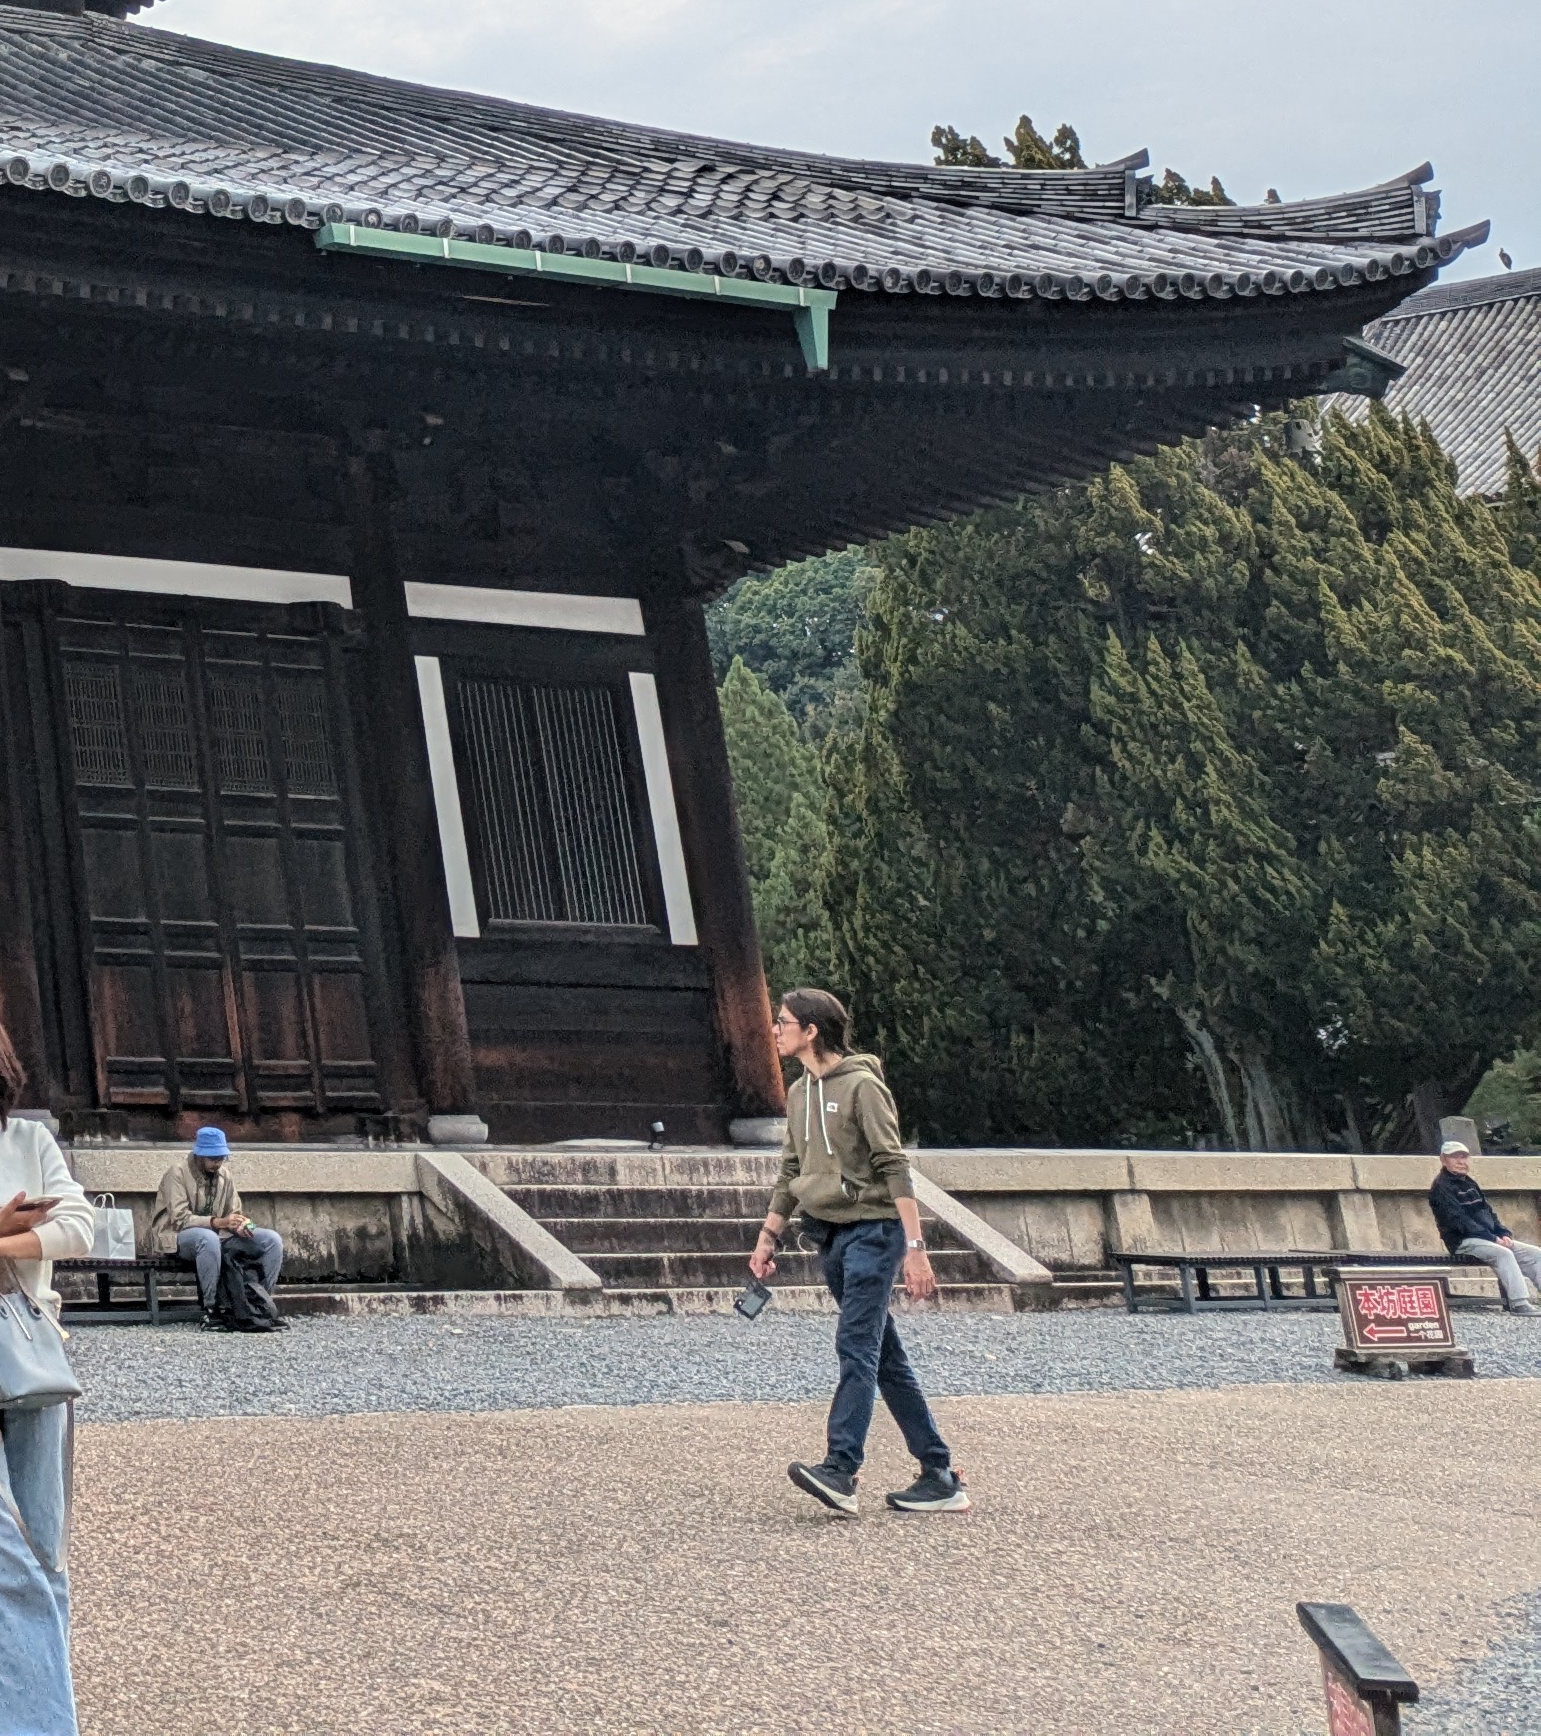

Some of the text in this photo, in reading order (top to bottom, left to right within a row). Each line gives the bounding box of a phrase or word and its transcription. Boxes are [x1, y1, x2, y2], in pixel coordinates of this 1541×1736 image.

[1356, 1285, 1439, 1319] 本坊庭園
[1408, 1321, 1440, 1331] garden
